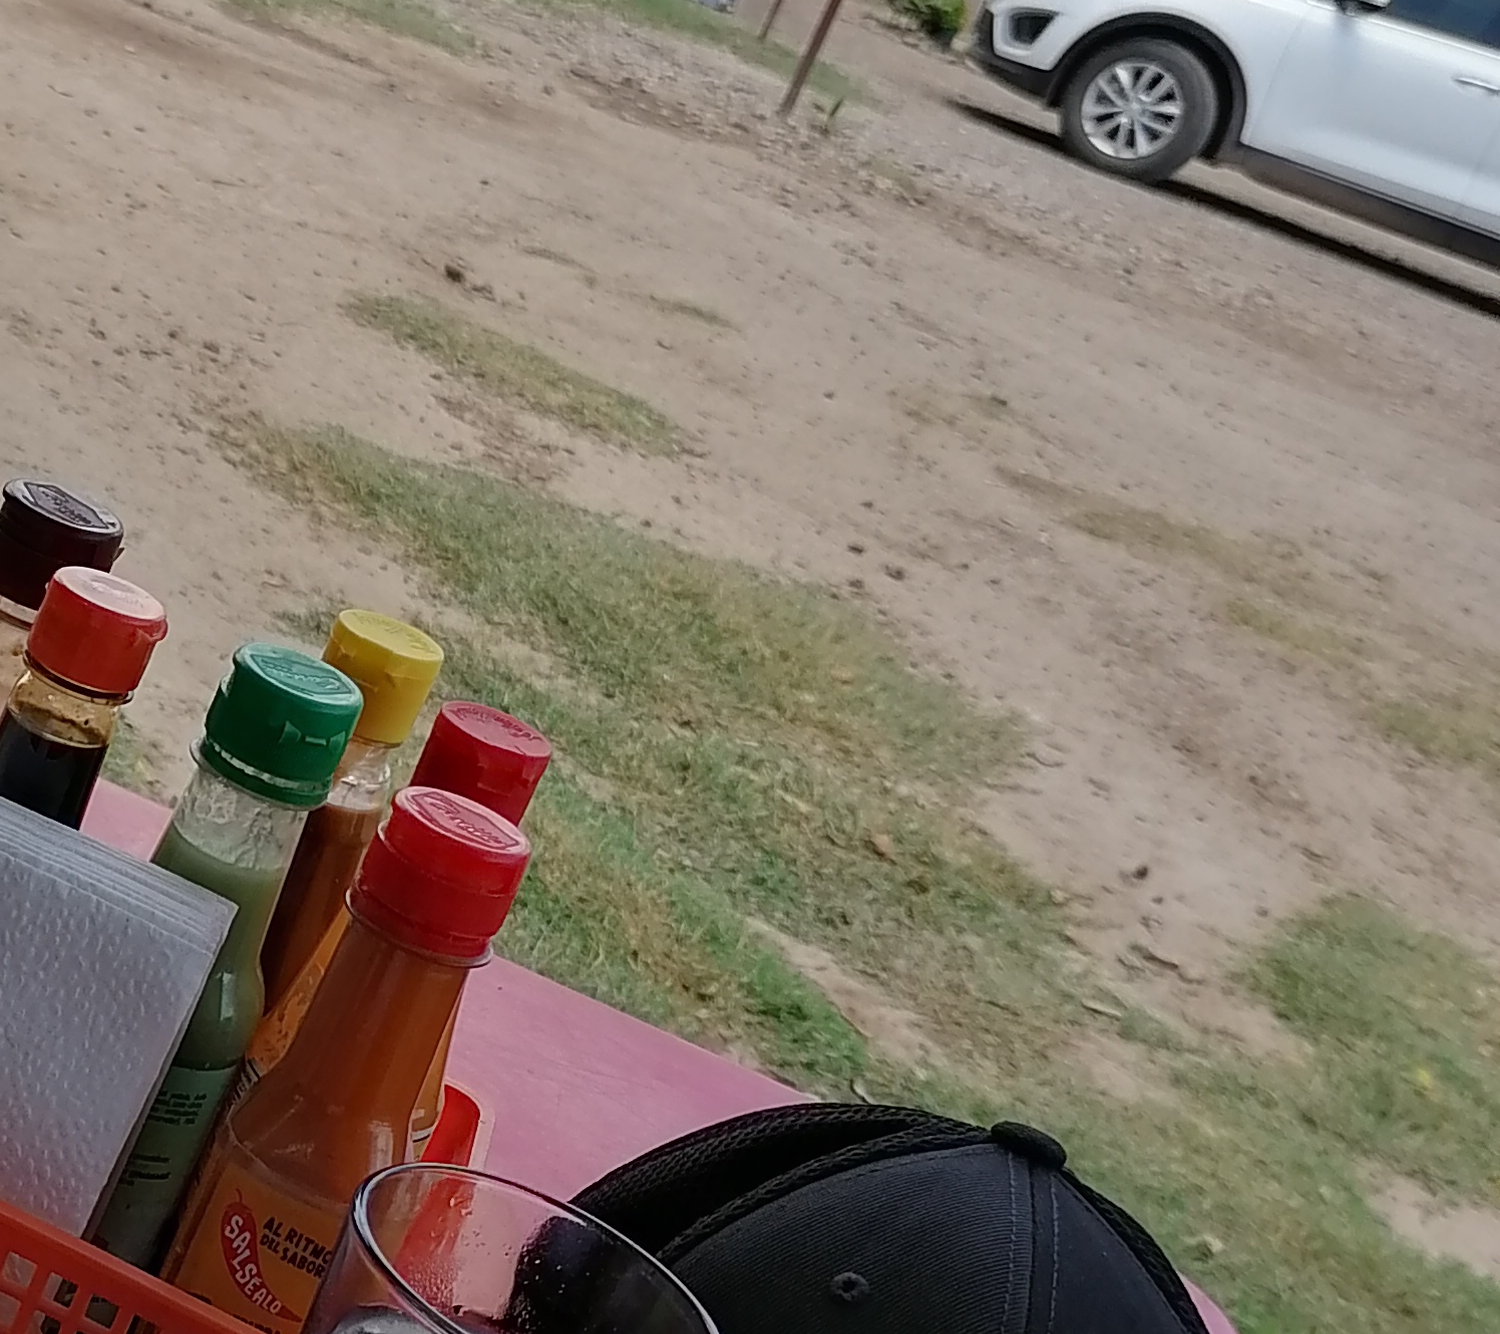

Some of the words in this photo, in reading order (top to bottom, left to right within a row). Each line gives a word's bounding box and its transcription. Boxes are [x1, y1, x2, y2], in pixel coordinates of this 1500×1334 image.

[263, 1217, 283, 1238] AL
[224, 1215, 282, 1314] SALSÉALO
[280, 1247, 326, 1278] SABOR
